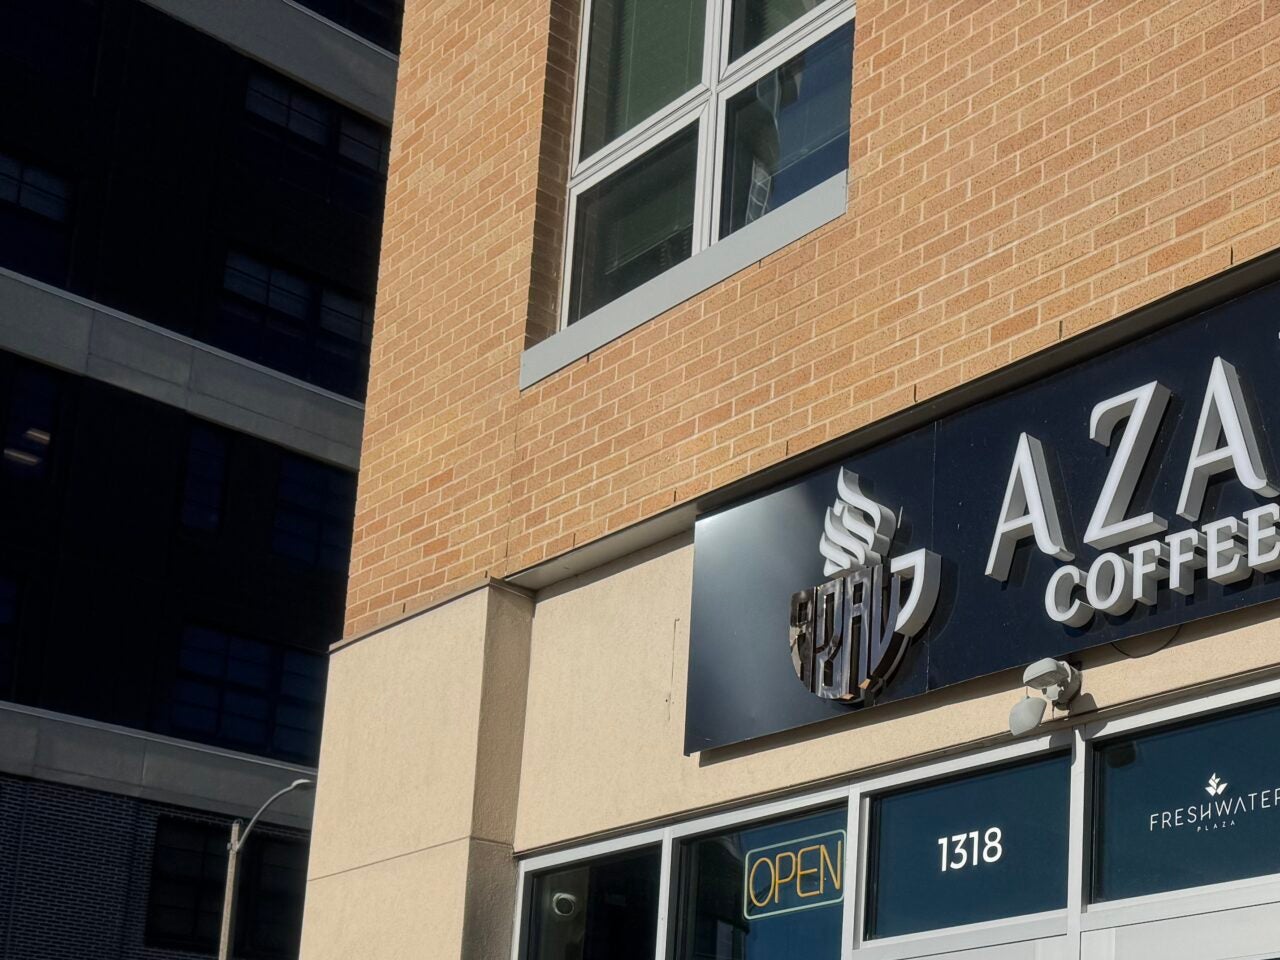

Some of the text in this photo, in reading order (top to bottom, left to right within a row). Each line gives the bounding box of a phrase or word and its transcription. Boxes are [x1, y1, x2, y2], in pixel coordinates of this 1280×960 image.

[937, 826, 1003, 872] 1318
[1196, 819, 1236, 833] PLAZA
[749, 839, 842, 907] OPEN
